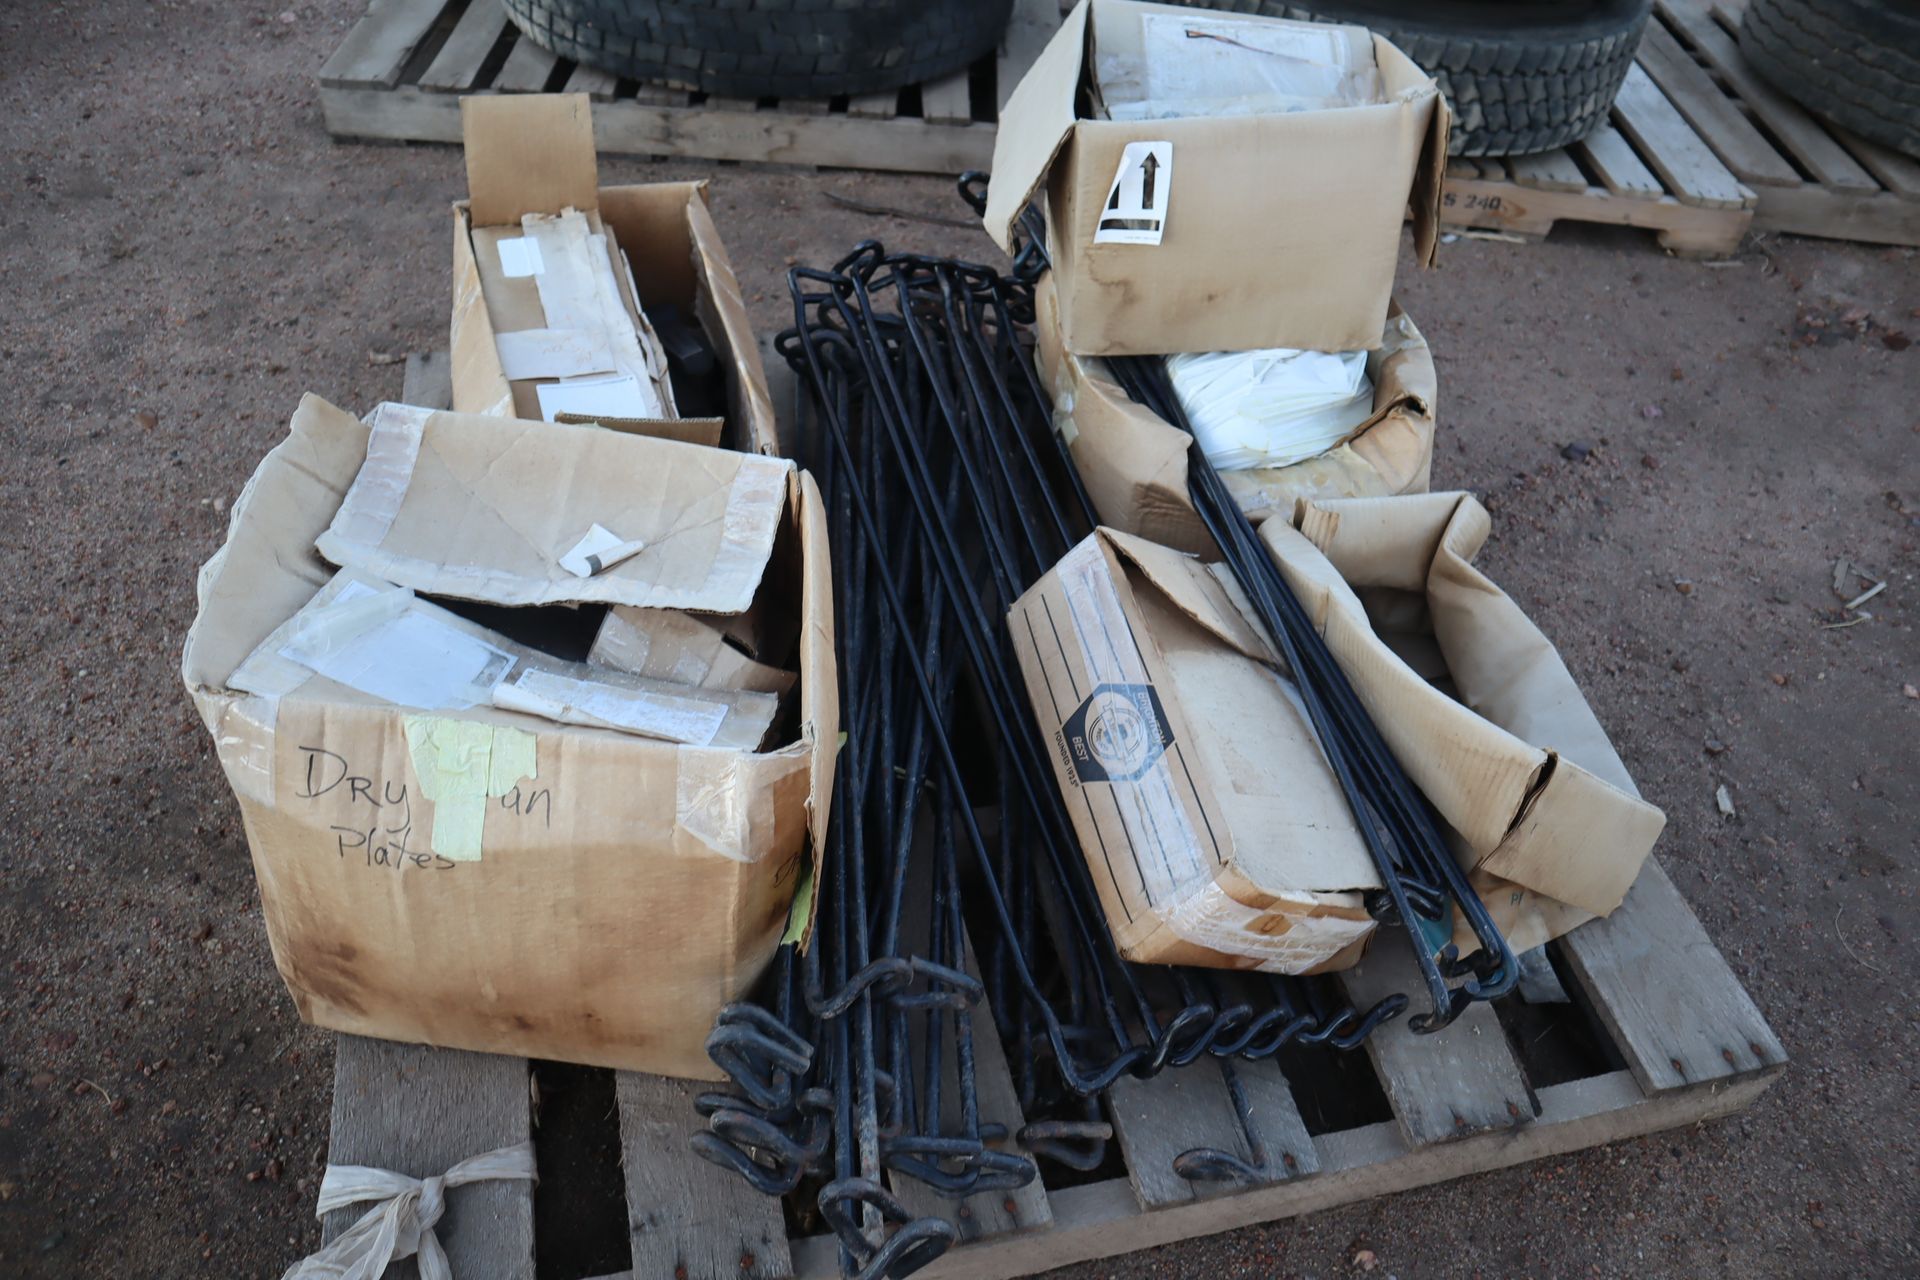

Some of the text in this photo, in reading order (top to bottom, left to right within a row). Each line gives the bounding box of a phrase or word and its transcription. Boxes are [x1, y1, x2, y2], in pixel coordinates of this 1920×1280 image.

[1054, 730, 1070, 766] FOUNDED
[1072, 736, 1089, 761] BEST
[330, 825, 455, 870] Plates
